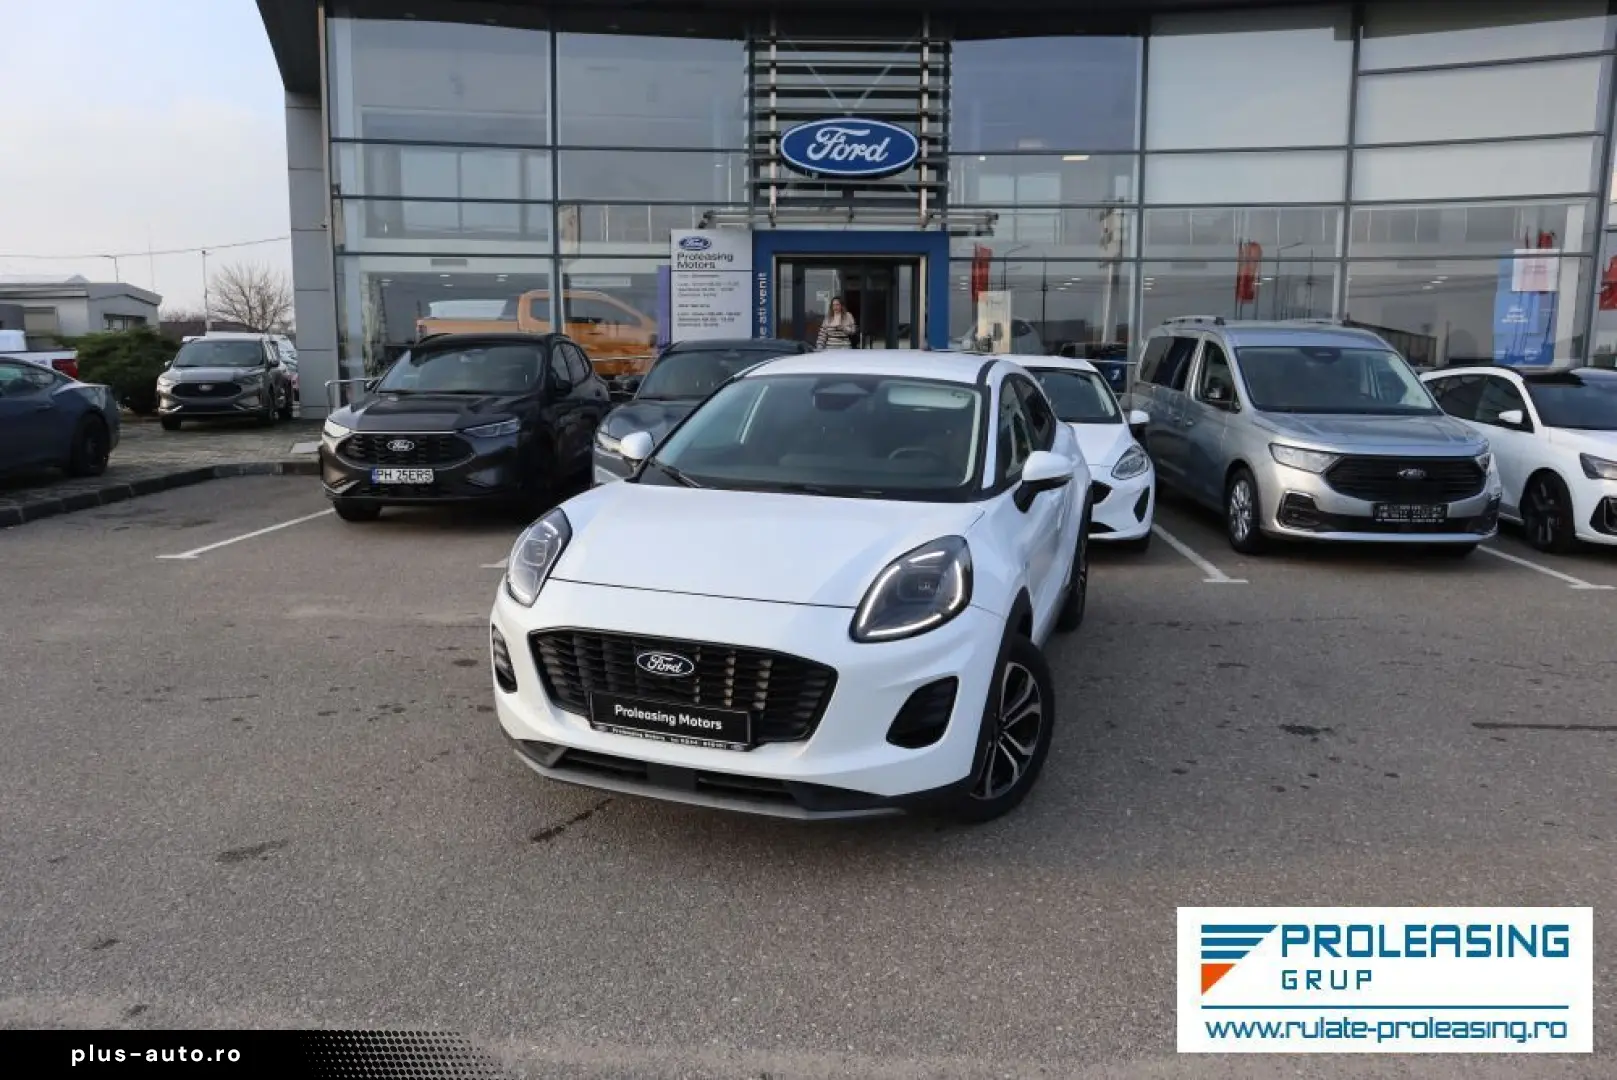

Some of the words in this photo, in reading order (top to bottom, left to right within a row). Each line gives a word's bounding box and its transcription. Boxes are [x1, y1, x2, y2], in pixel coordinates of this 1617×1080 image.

[806, 126, 892, 163] Ford
[677, 252, 733, 262] Proleasing
[677, 261, 716, 269] Motors
[376, 470, 392, 480] PH
[646, 654, 683, 674] Ford
[614, 704, 677, 726] Proleasing
[678, 713, 723, 730] Motors
